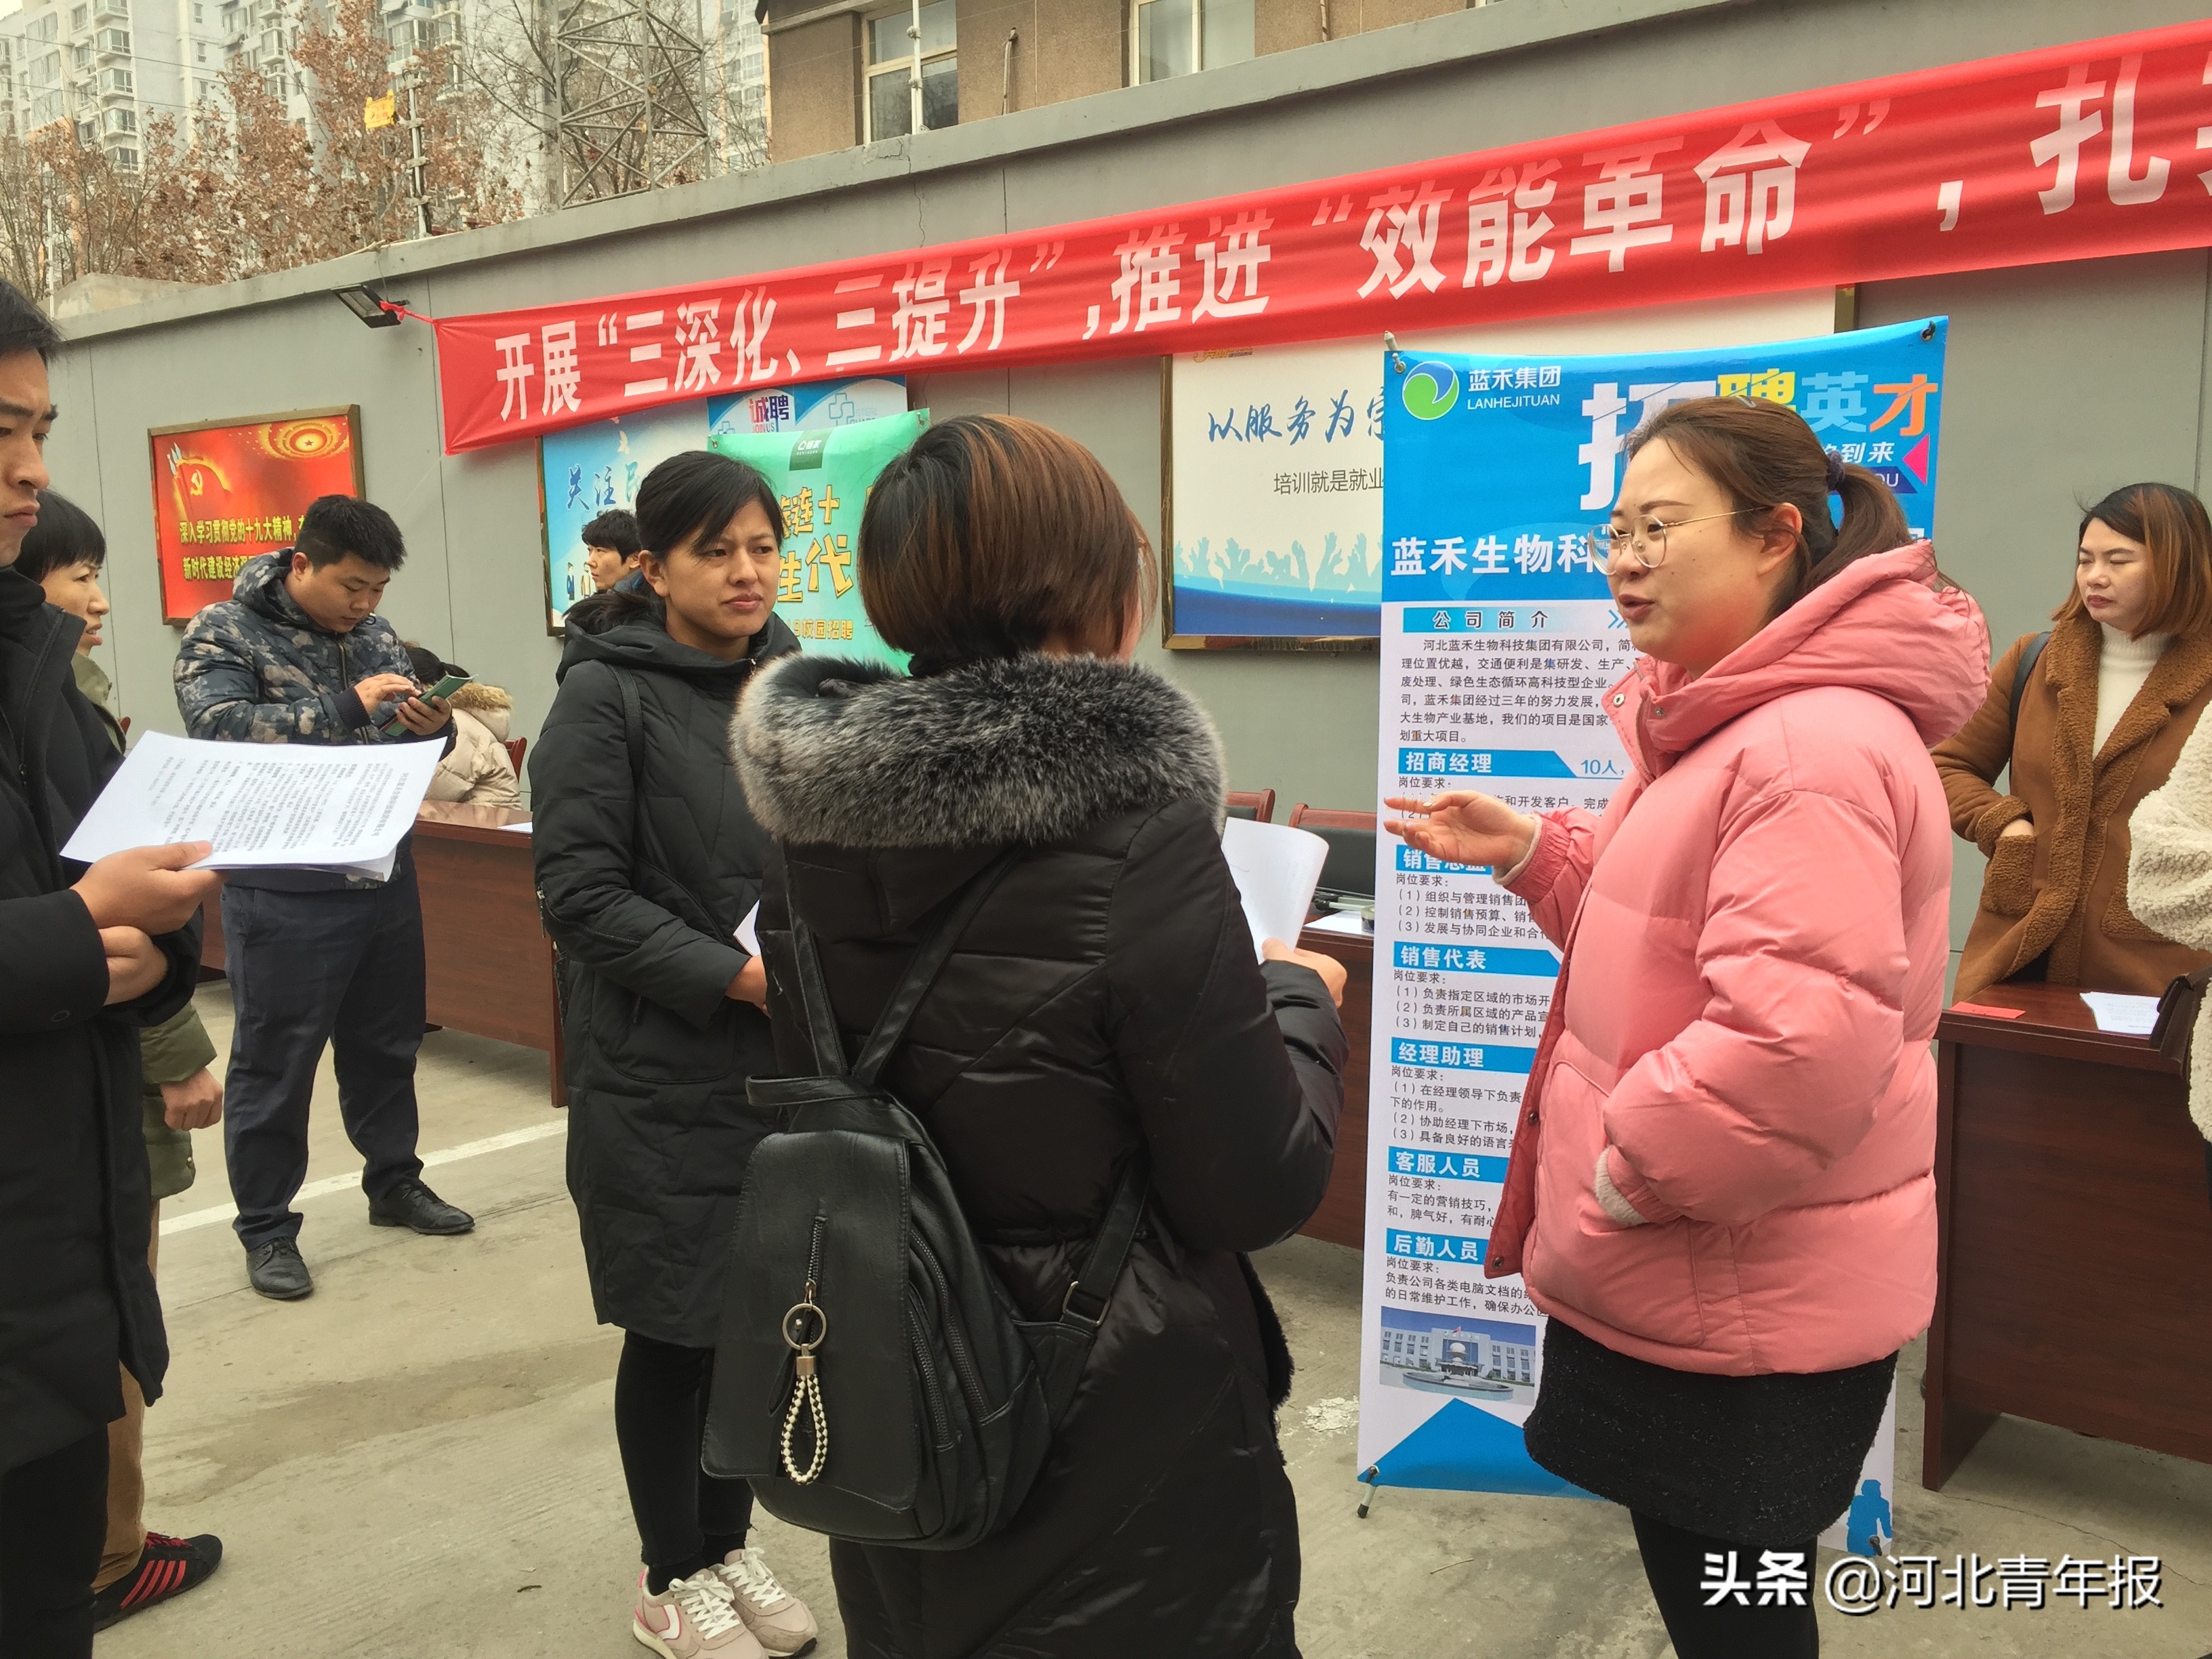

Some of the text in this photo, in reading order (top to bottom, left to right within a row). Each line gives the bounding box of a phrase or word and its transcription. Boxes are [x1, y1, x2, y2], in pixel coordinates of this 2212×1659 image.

[1468, 365, 1561, 392] 蓝禾集团
[749, 394, 790, 424] 诚聘
[1467, 394, 1560, 410] LANHEJITUAN
[1273, 467, 1384, 495] 培训就是就业
[1433, 611, 1548, 629] 公司简介
[1423, 639, 1637, 653] 河北蓝禾生物科技集团有限公司，简
[1401, 676, 1613, 689] 废处理、绿色生态循环高科技型企业。
[1400, 695, 1599, 708] 司，蓝禾集团经过三年的努力发展，
[1399, 712, 1608, 726] 大生物产业基地，我们的项目是国家
[1399, 731, 1467, 743] 划重大项目。
[1406, 752, 1492, 773] 招商经理
[1399, 777, 1451, 790] 岗位要求：
[1396, 873, 1448, 886] 岗位要求：
[1398, 922, 1548, 939] （3）发展与协同企业和合
[1401, 945, 1486, 970] 销售代表
[1393, 969, 1446, 984] 岗位要求：
[1398, 1041, 1484, 1068] 经理助理
[1391, 1065, 1443, 1081] 岗位要求：
[1391, 1097, 1444, 1113] 下的作用。
[1395, 1151, 1480, 1179] 客服人员
[1388, 1174, 1441, 1191] 岗位要求：
[1387, 1190, 1491, 1212] 有一定的营销技巧，
[1394, 1234, 1479, 1261] 后勤人员
[1387, 1256, 1439, 1273] 岗位要求：
[1385, 1287, 1549, 1317] 的日常维护工作，确保办公
